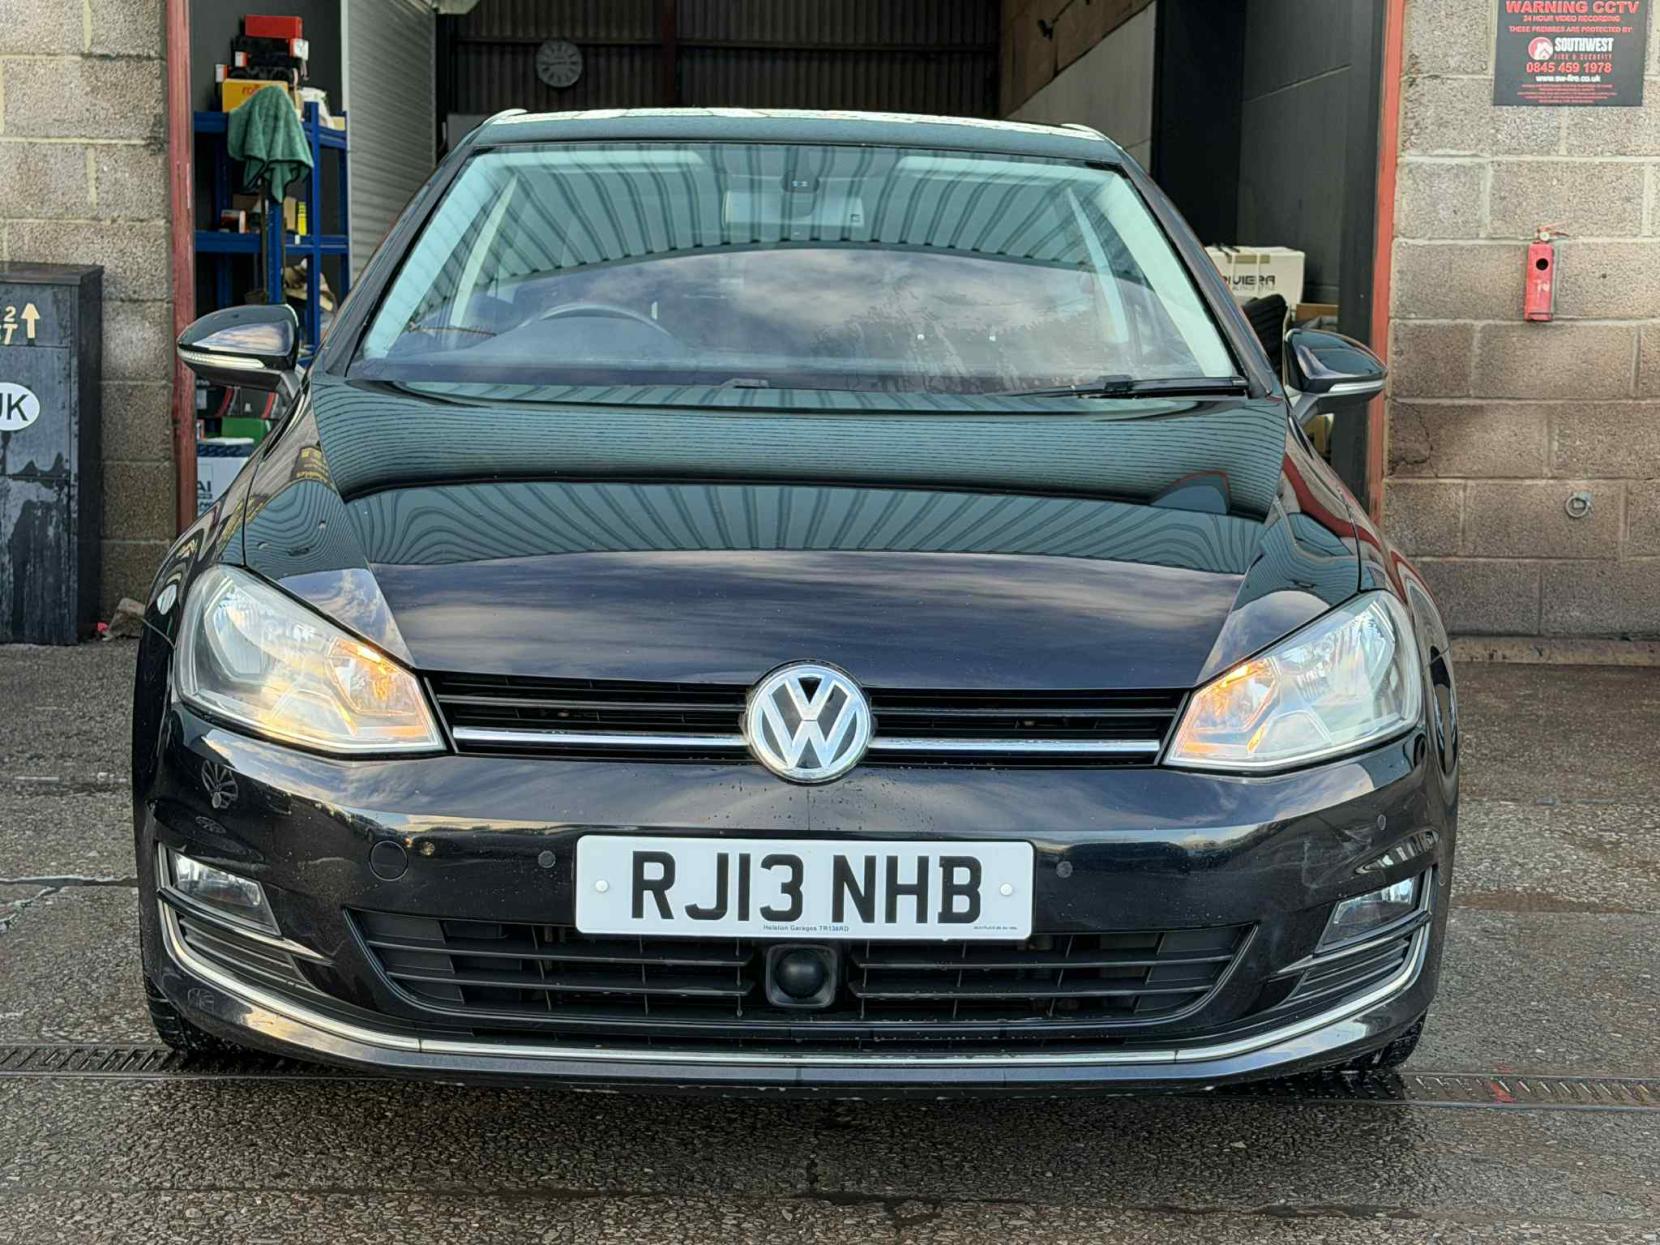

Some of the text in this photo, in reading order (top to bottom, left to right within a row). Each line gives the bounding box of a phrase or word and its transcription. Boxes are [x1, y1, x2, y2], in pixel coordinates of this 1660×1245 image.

[1506, 1, 1640, 13] WARNING CCTV
[1509, 25, 1531, 33] THESE
[1532, 25, 1566, 33] PREMISES
[1566, 25, 1581, 33] ARE
[1581, 25, 1621, 33] PROTECTED
[1554, 37, 1614, 52] SOUTHWEST
[1526, 62, 1612, 73] 0845 459 1978
[0, 393, 29, 421] K
[631, 850, 982, 924] RJ13 NHB
